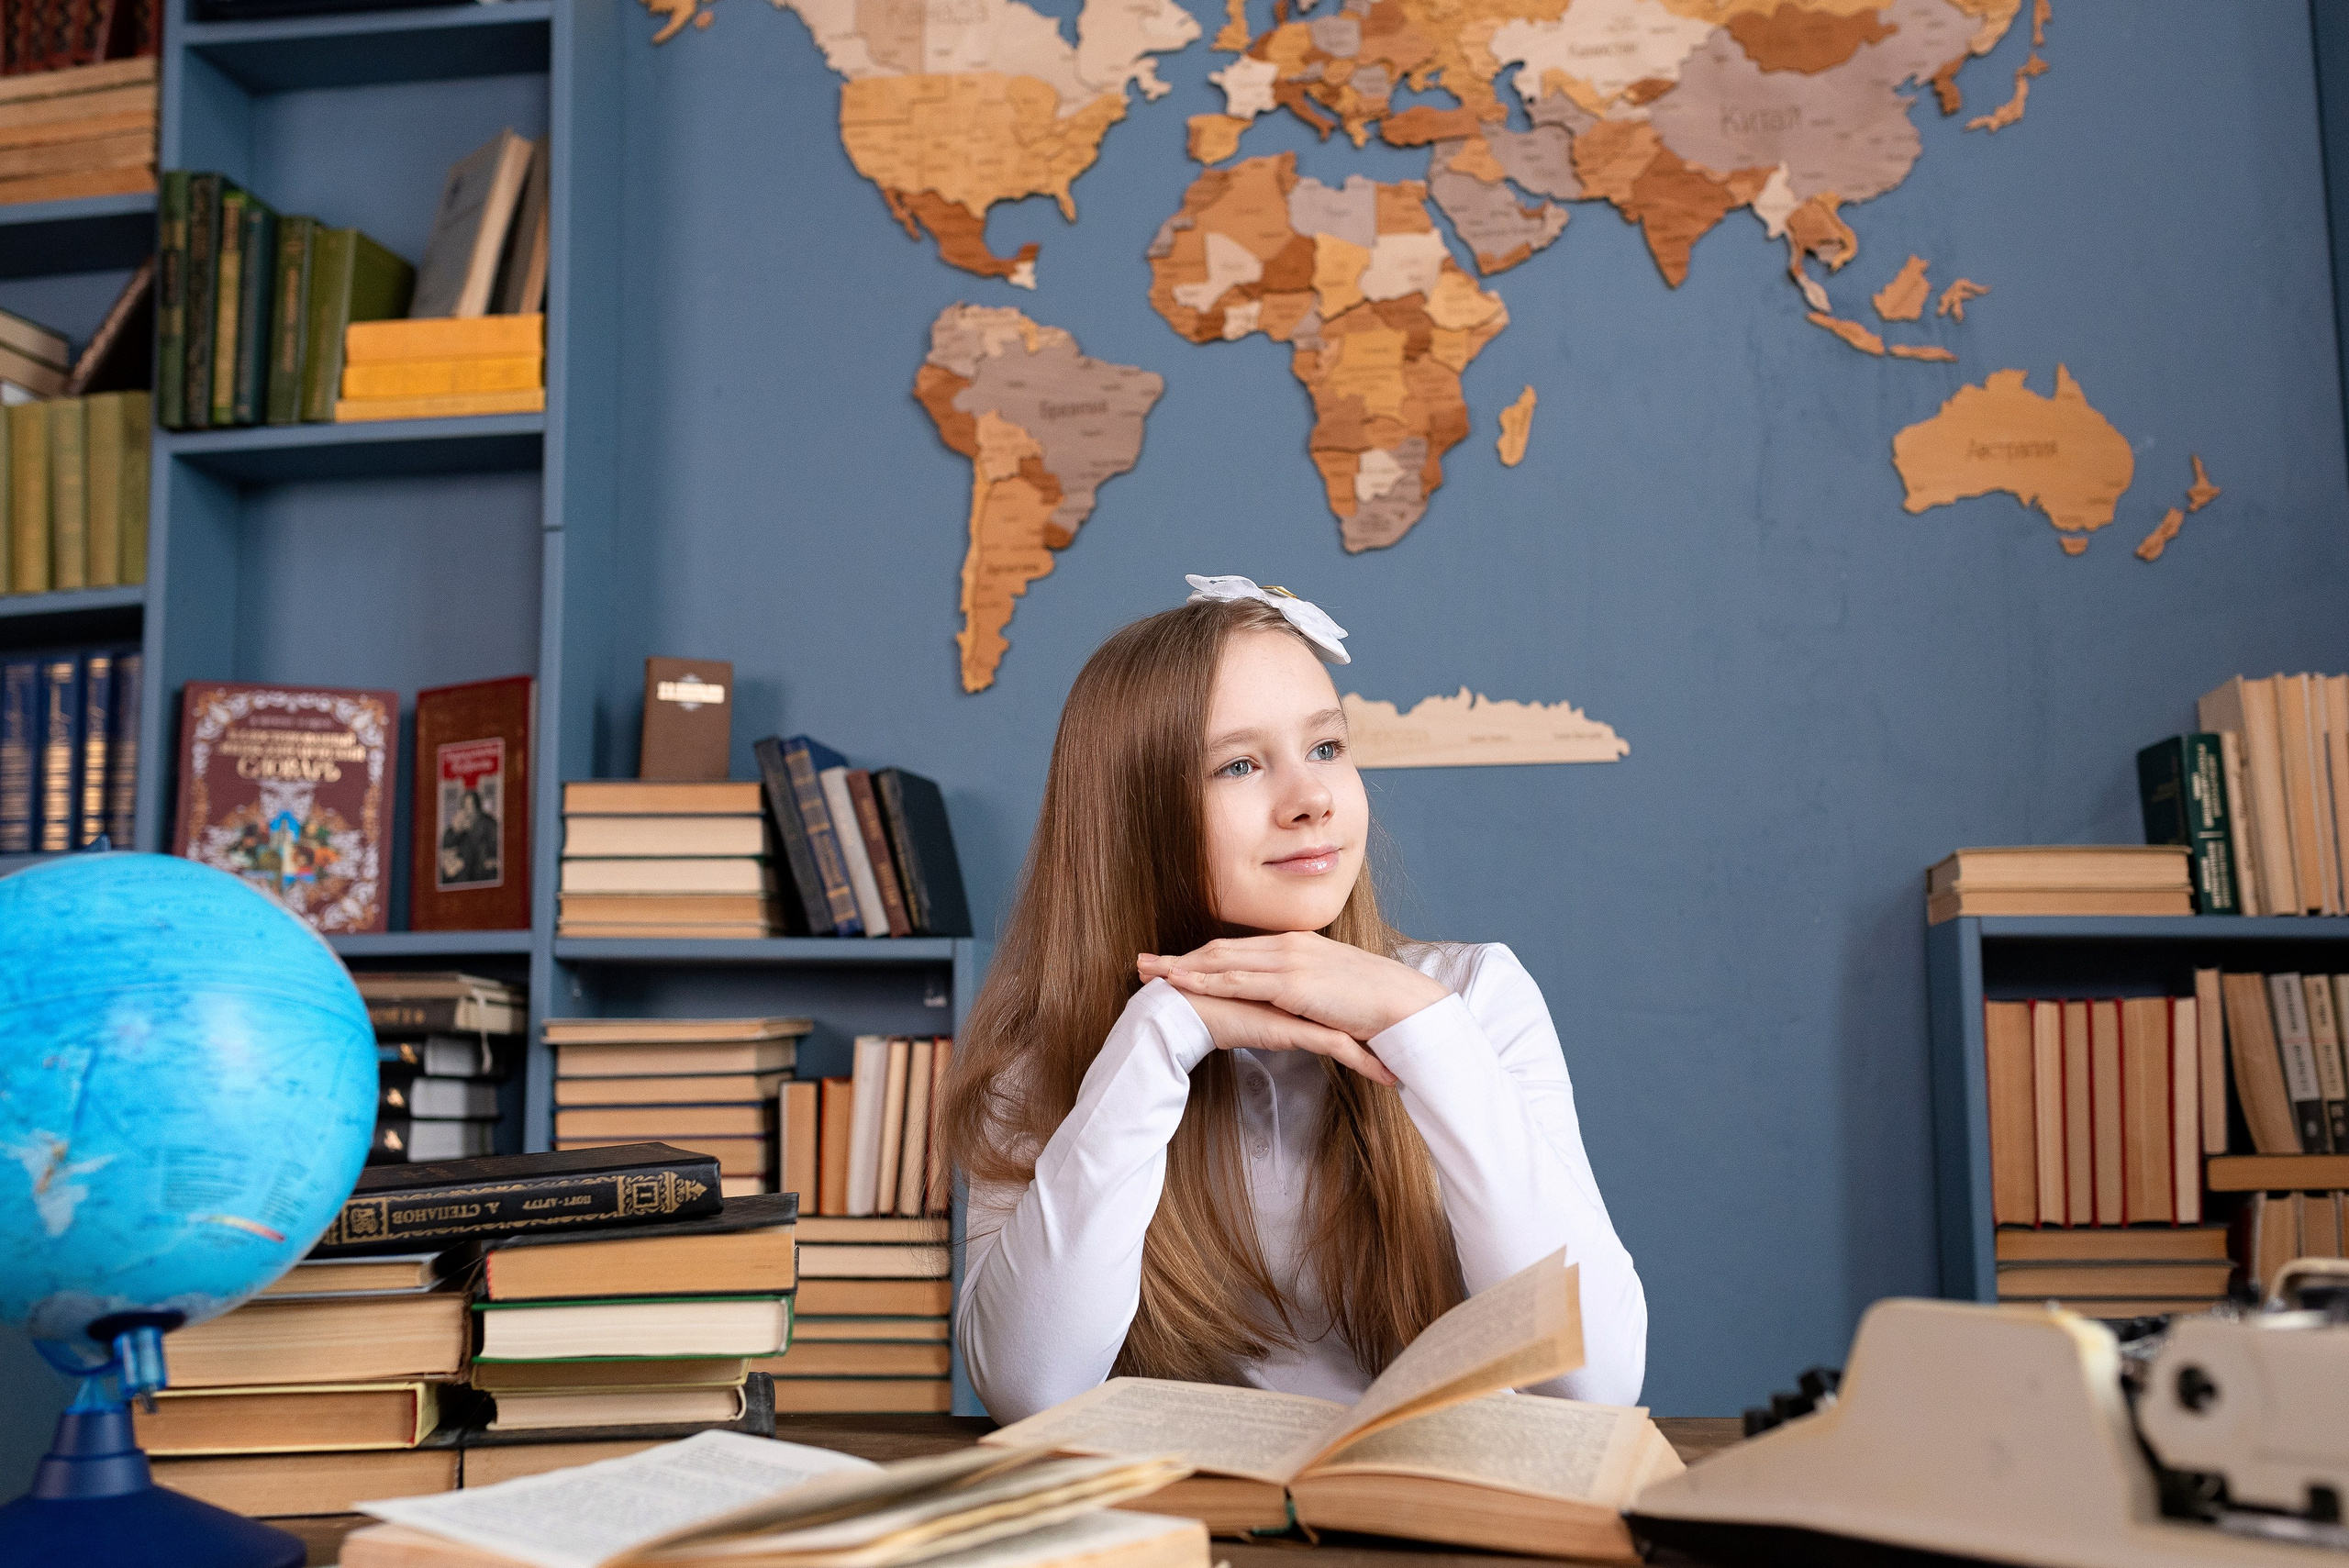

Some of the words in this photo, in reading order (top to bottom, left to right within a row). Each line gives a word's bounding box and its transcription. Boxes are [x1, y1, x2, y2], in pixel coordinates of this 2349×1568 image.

[1720, 104, 1802, 135] Китай
[1966, 438, 2058, 464] Австралия
[392, 1203, 482, 1225] СТЕПАНОВ
[522, 1195, 592, 1210] ПОРТ-АРТУР
